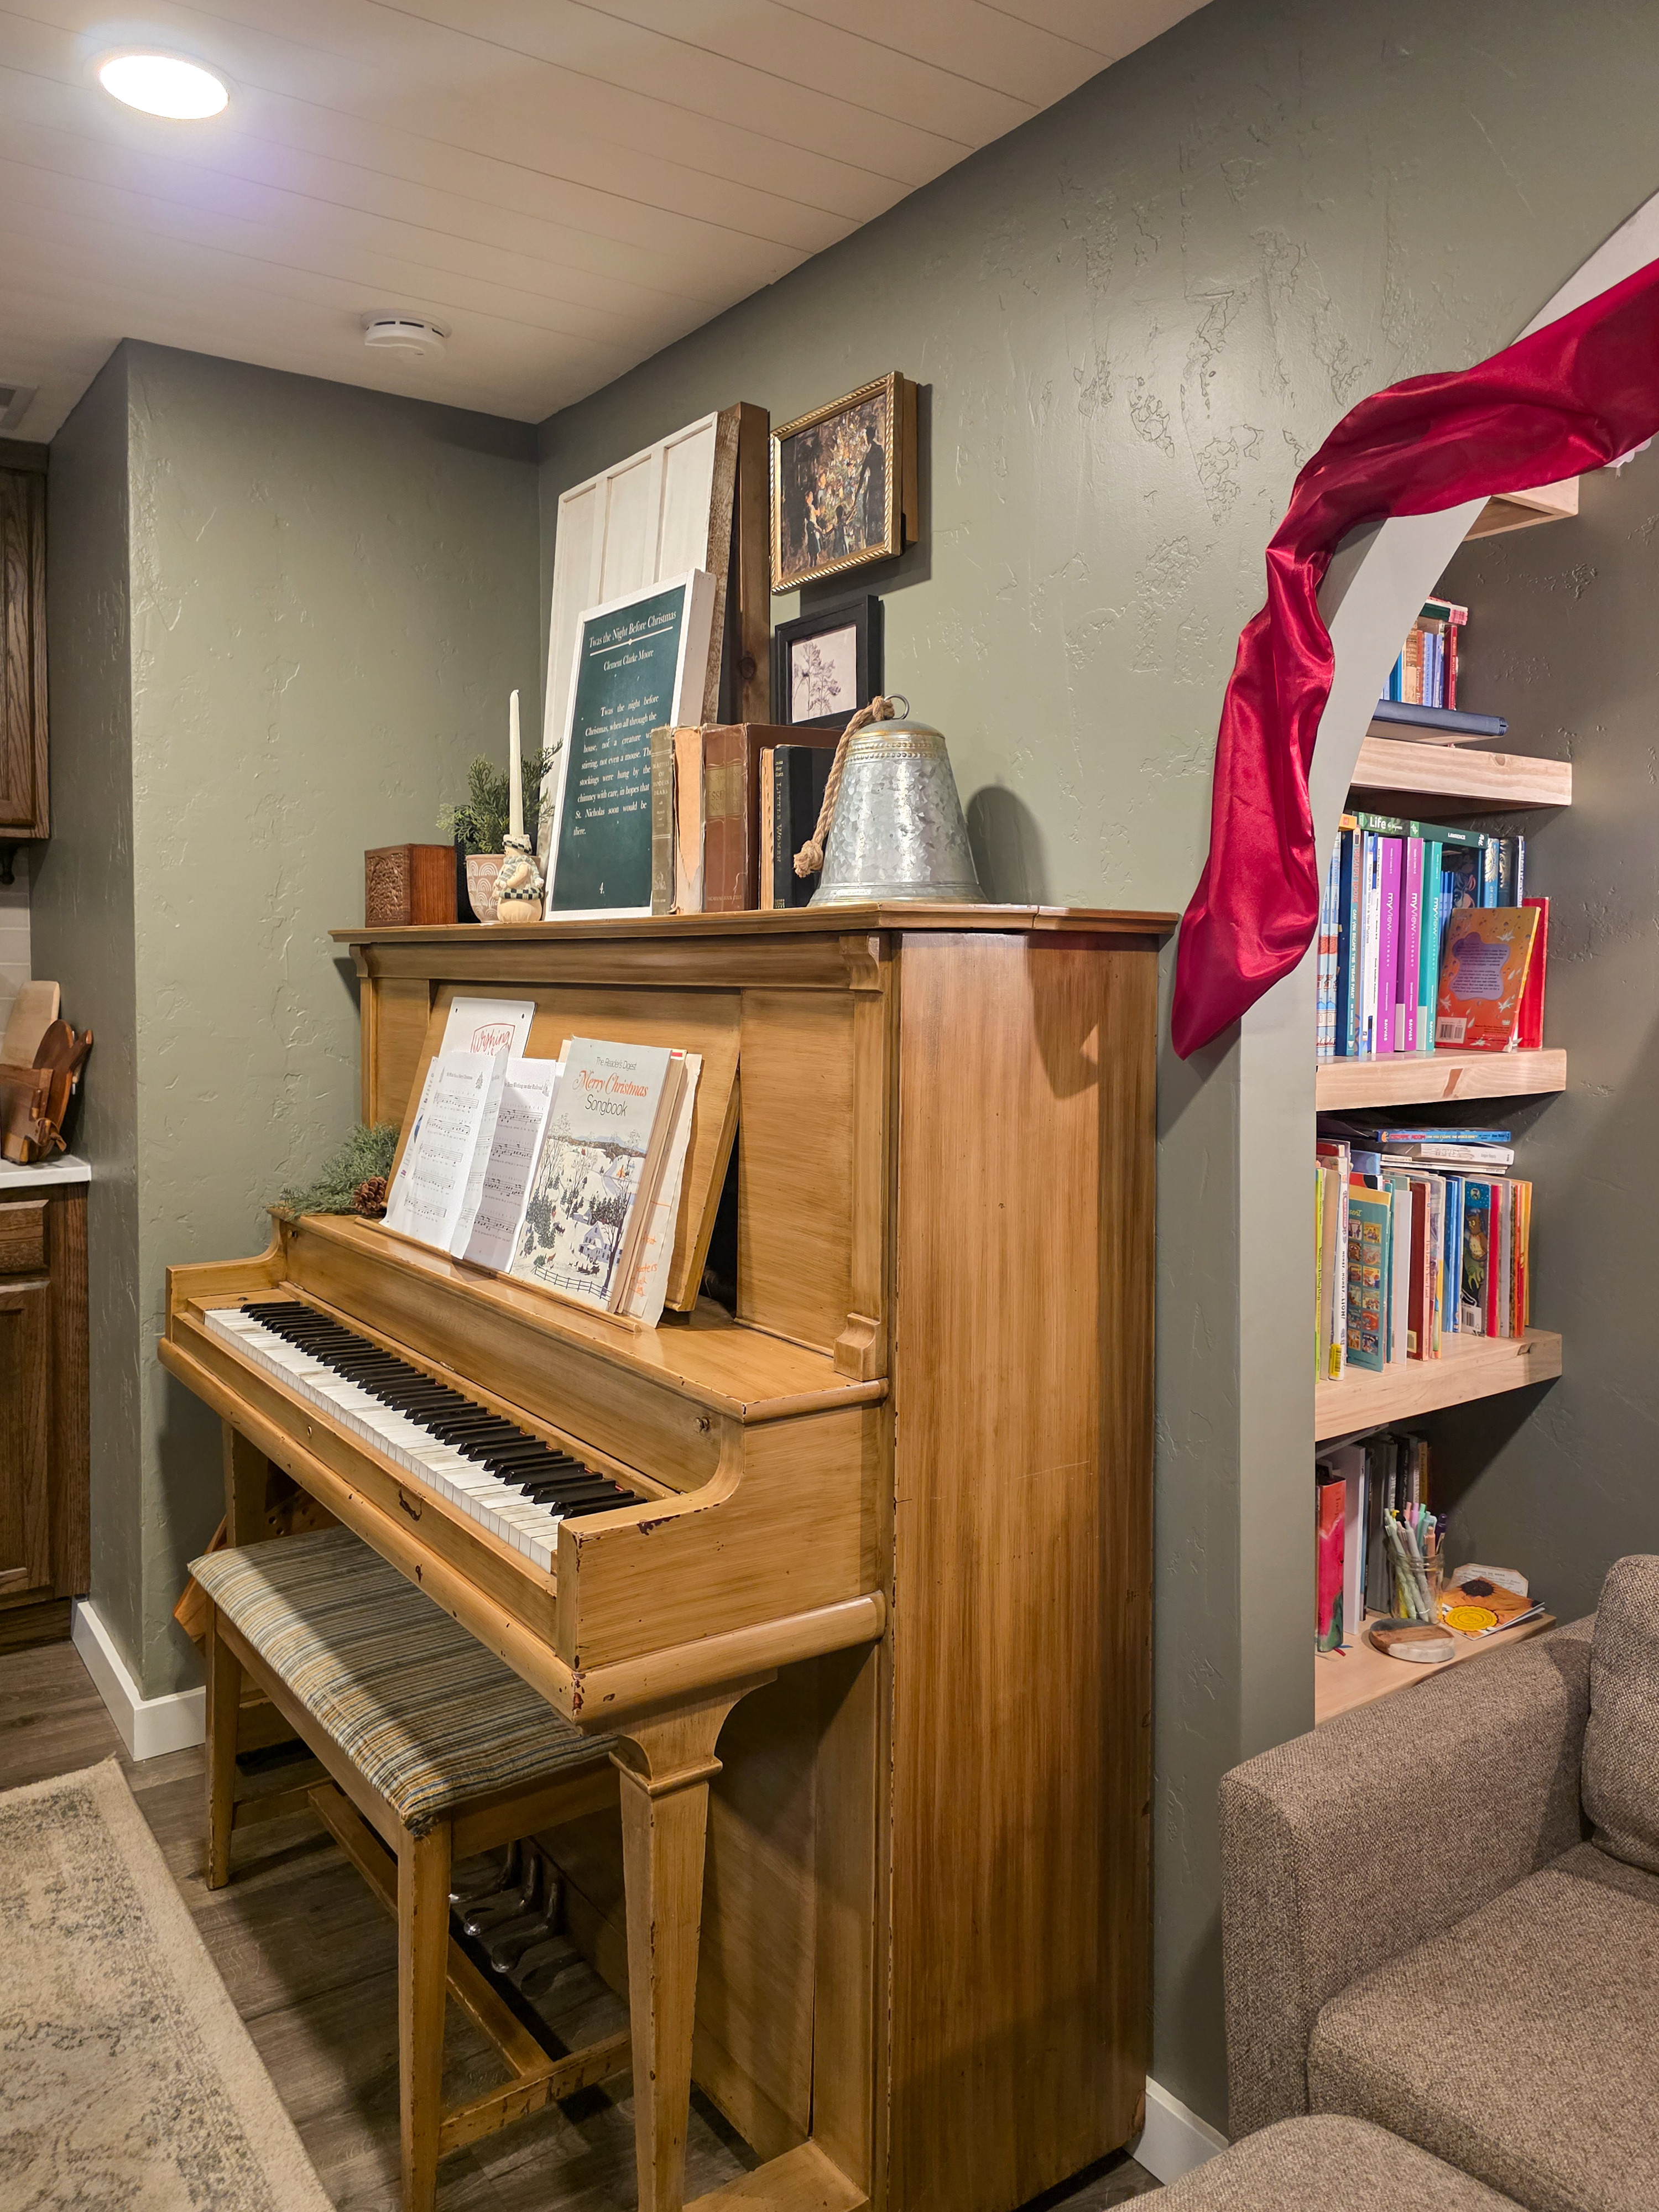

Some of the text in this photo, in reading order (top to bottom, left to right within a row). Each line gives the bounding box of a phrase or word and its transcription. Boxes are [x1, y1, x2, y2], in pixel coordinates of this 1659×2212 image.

[589, 611, 676, 648] Twas the Night Before Christmas
[603, 649, 654, 671] Clement Clarke Moore
[601, 706, 613, 717] Twas
[628, 699, 640, 711] night
[643, 695, 659, 706] before
[585, 726, 608, 737] Christmas,
[609, 721, 622, 731] when
[629, 713, 648, 726] through
[649, 712, 657, 721] the
[583, 744, 597, 753] house,
[602, 738, 611, 749] not
[622, 734, 641, 745] creature
[581, 760, 598, 770] stirring,
[608, 756, 619, 764] even
[624, 752, 641, 761] mouse.
[580, 775, 599, 786] stockings
[617, 770, 629, 780] hung
[633, 767, 639, 778] by
[643, 764, 651, 774] the
[577, 782, 650, 803] chimney with care, in hopes that
[585, 807, 605, 818] Nicholas
[623, 801, 638, 812] would
[640, 800, 647, 809] be
[573, 826, 586, 836] there.
[1370, 816, 1386, 830] Life
[623, 1060, 637, 1071] Digest
[572, 1070, 649, 1097] Merry Christmas
[585, 1094, 628, 1117] Songbook
